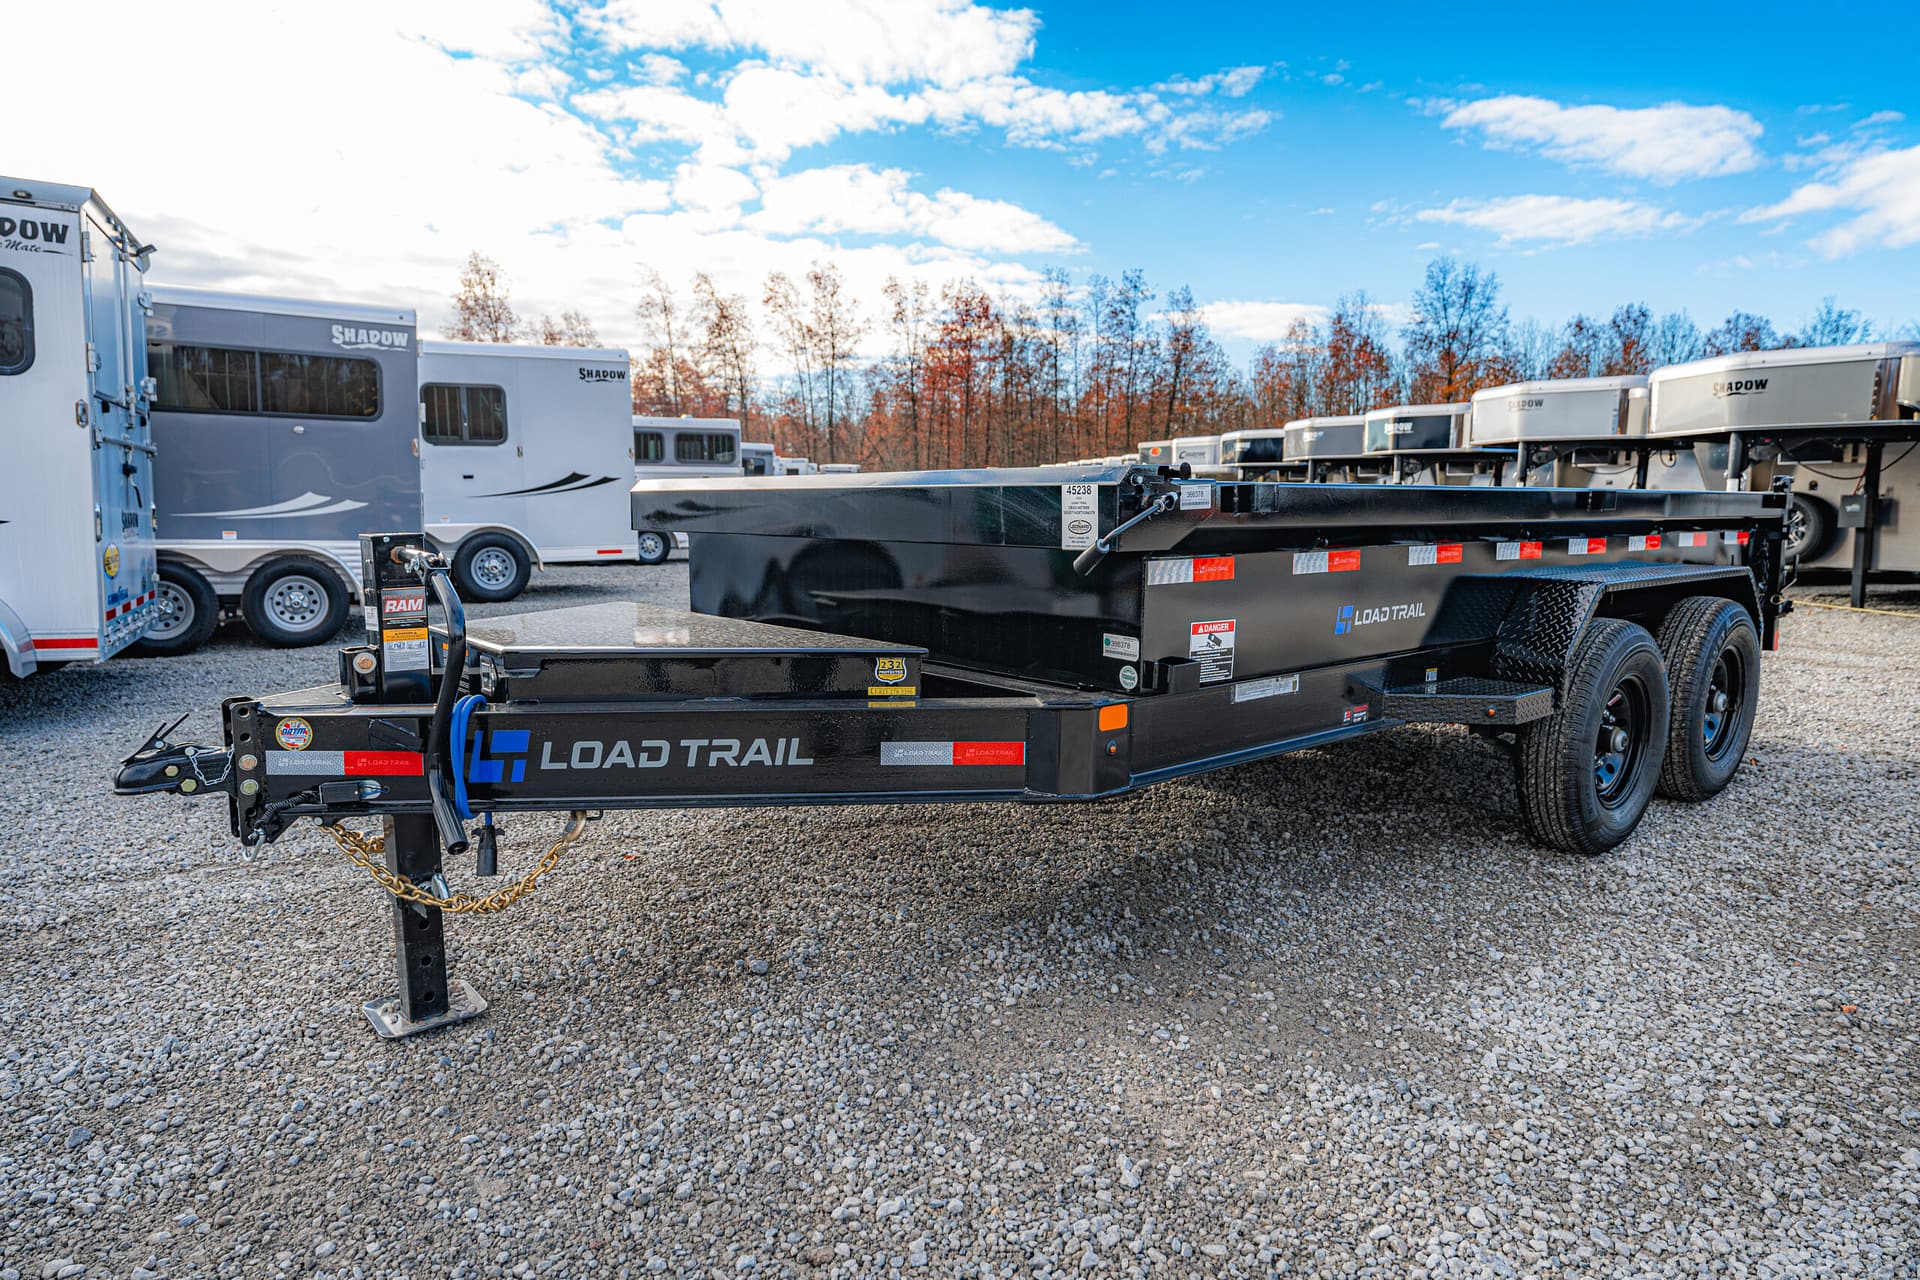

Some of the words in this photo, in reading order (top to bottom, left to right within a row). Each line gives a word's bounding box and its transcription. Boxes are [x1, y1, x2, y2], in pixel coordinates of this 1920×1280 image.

[332, 324, 409, 347] SHADOW
[579, 367, 626, 380] SHADOW
[1713, 378, 1768, 396] SHADOW
[1066, 485, 1092, 495] 45238
[385, 599, 424, 613] RAM
[1354, 607, 1390, 626] LOAD
[1391, 602, 1426, 621] TRAIL
[1204, 623, 1230, 633] DANGER
[540, 740, 671, 770] LOAD
[680, 737, 814, 767] TRAIL
